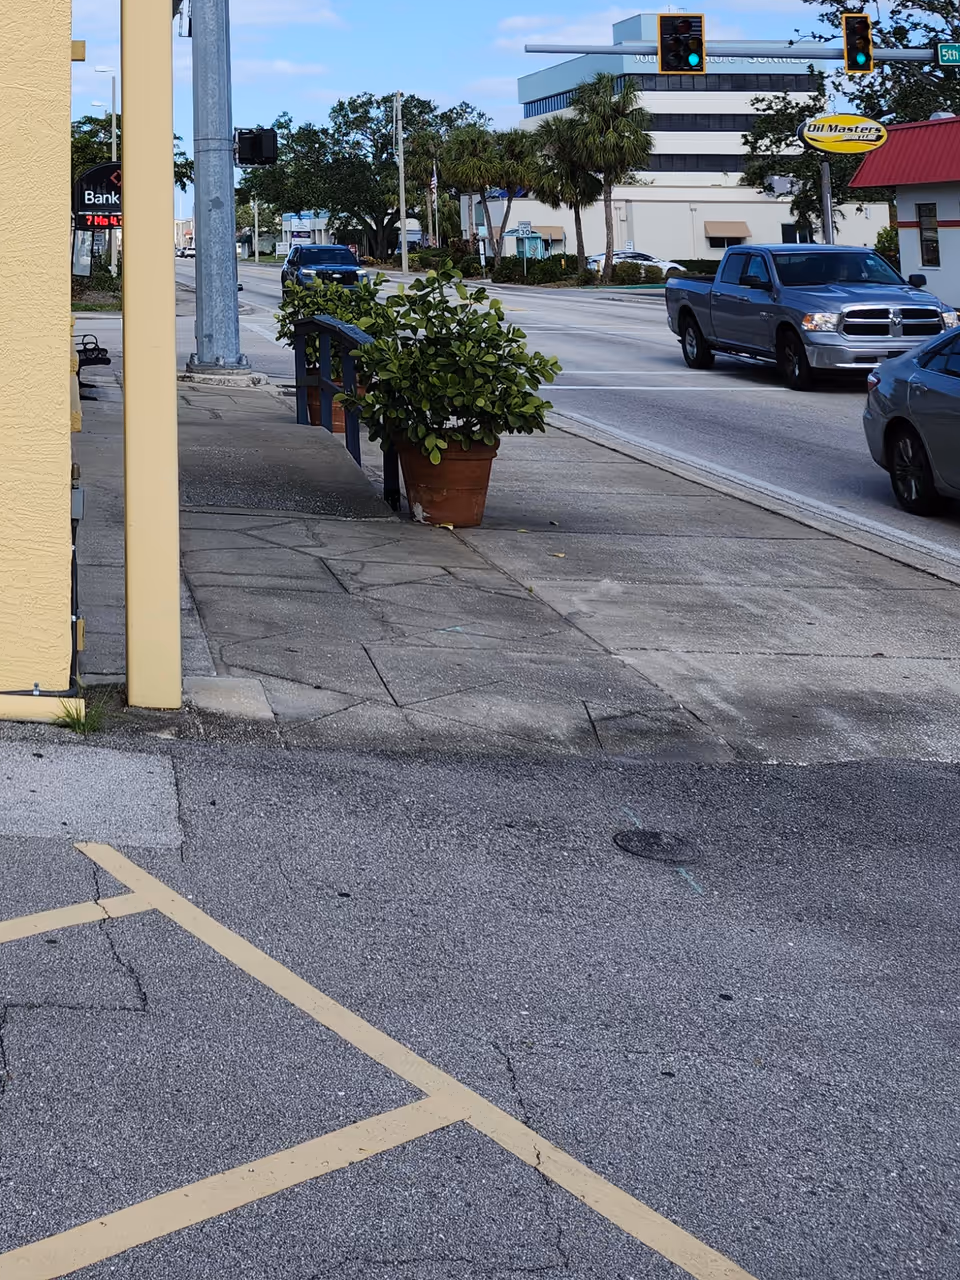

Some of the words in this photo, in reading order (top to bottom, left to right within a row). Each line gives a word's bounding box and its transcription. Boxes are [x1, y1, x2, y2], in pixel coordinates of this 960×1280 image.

[942, 49, 959, 60] 5th
[807, 123, 825, 133] Oil
[827, 124, 882, 134] Masters
[84, 190, 120, 204] Bank
